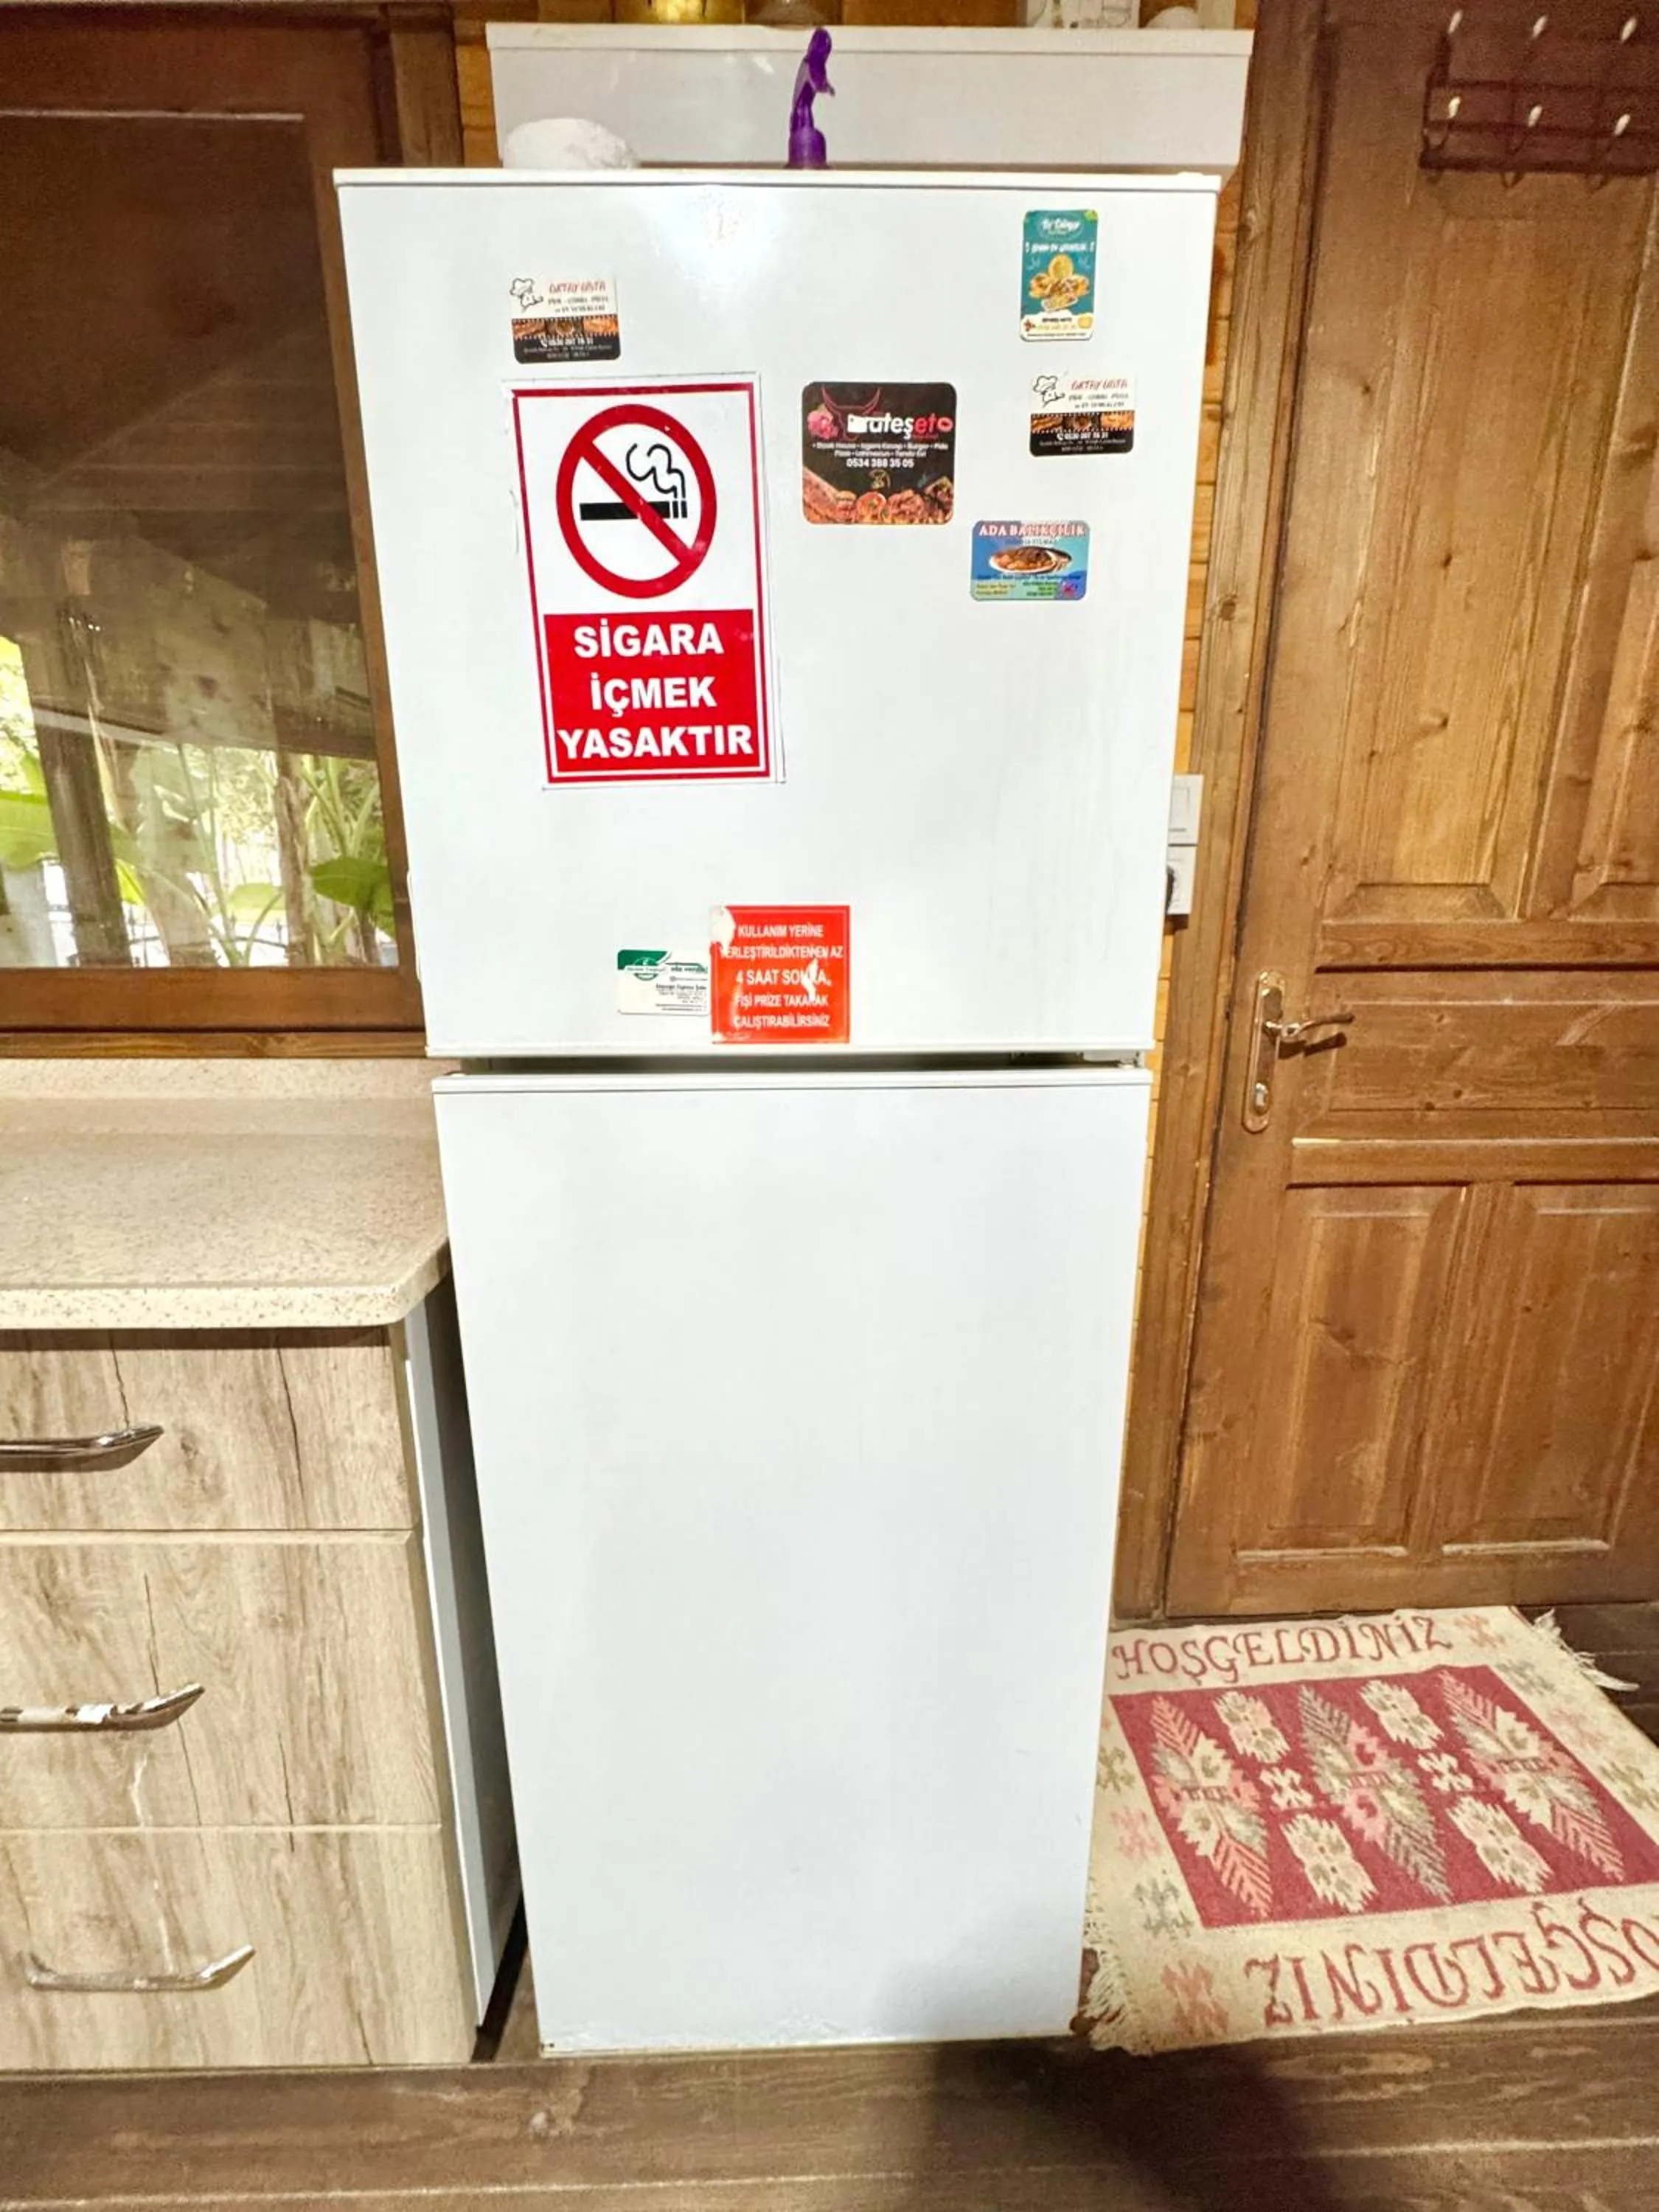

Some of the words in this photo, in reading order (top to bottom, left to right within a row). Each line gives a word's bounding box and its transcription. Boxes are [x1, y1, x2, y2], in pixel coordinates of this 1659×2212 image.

[978, 524, 1007, 536] ADA
[574, 618, 725, 658] SİGARA
[591, 672, 718, 718] İÇMEK
[557, 724, 754, 759] YASAKTIR
[737, 925, 787, 938] KULLANIM
[789, 922, 824, 938] YERİNE
[736, 970, 743, 984] 4
[745, 969, 779, 985] SAAT
